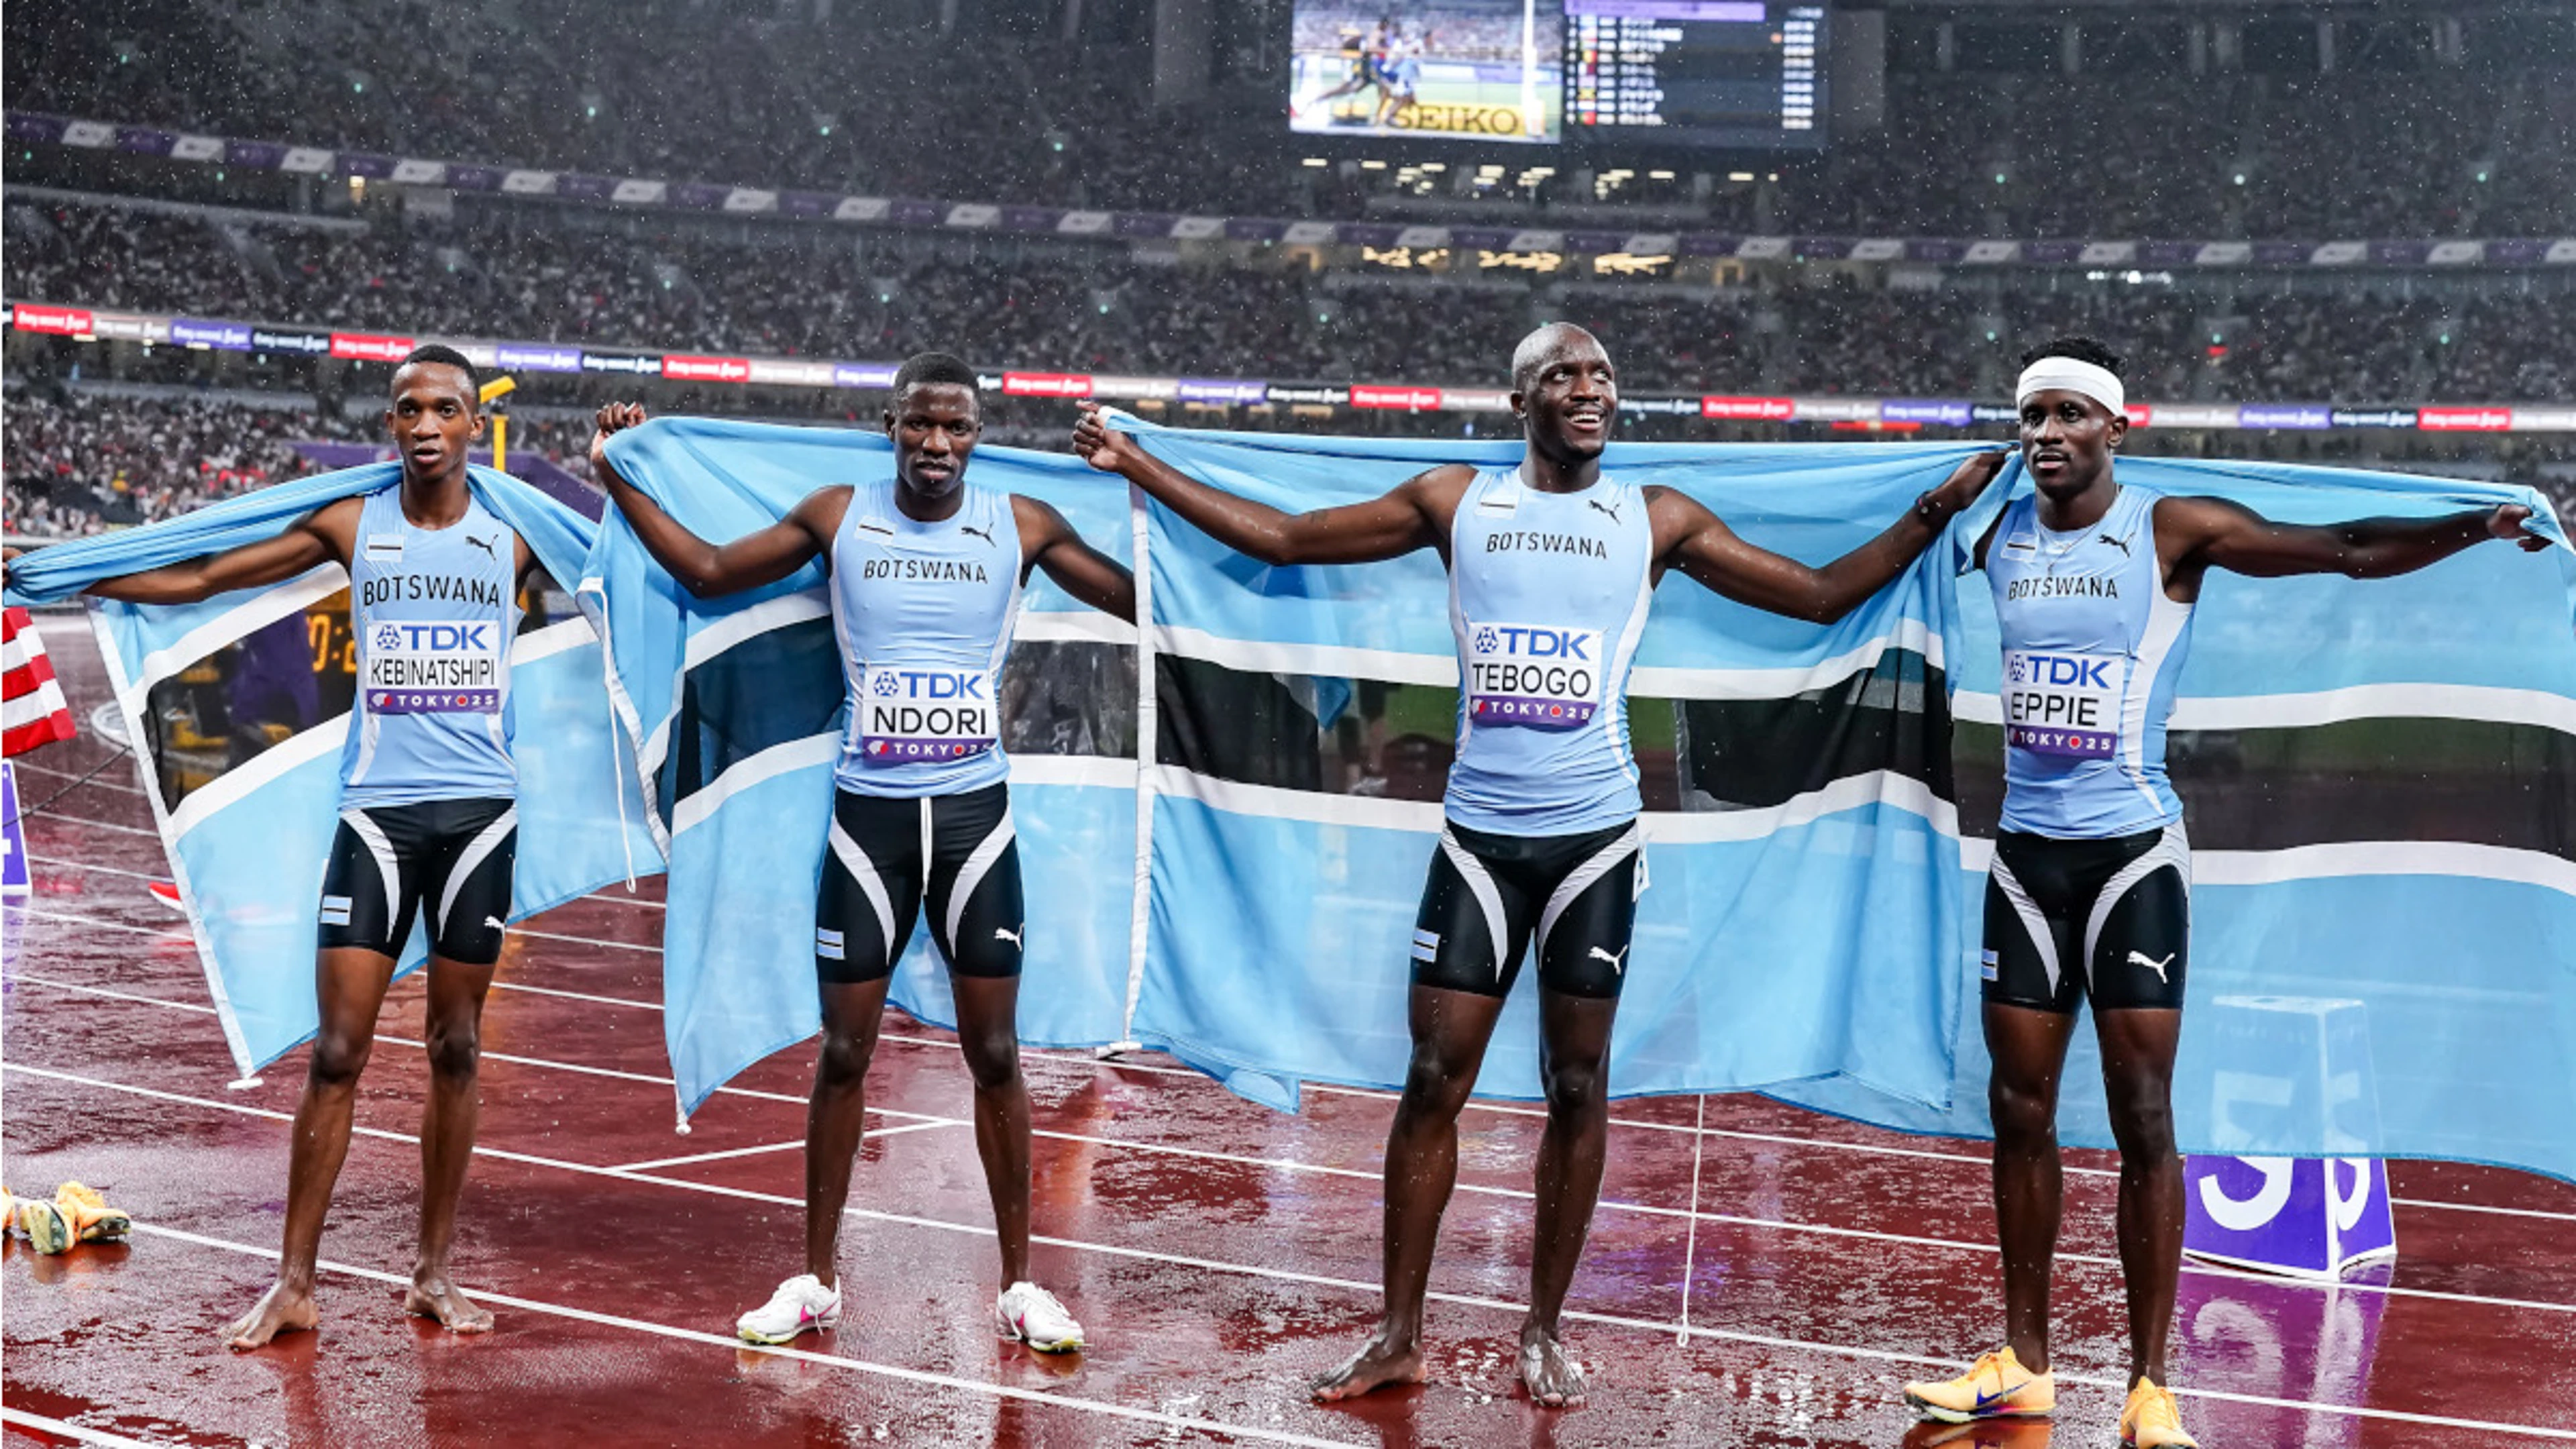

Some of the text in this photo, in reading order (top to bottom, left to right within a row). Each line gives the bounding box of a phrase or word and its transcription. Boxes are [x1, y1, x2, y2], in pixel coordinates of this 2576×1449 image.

[1386, 105, 1517, 134] SEIKO
[1487, 532, 1607, 559] BOTSWANA
[863, 559, 988, 584] BOTSWANA
[364, 575, 500, 607] BOTSWANA
[2008, 576, 2119, 600] BOTSWANA
[400, 625, 489, 651] TDK
[1500, 628, 1591, 661] TDK
[370, 658, 495, 686] KEBINATSHIPI
[900, 672, 985, 700] TDK
[1472, 663, 1592, 698] TEBOGO
[2027, 655, 2112, 689] TDK
[873, 706, 986, 735] NDORI
[2010, 692, 2100, 727] EPPIE
